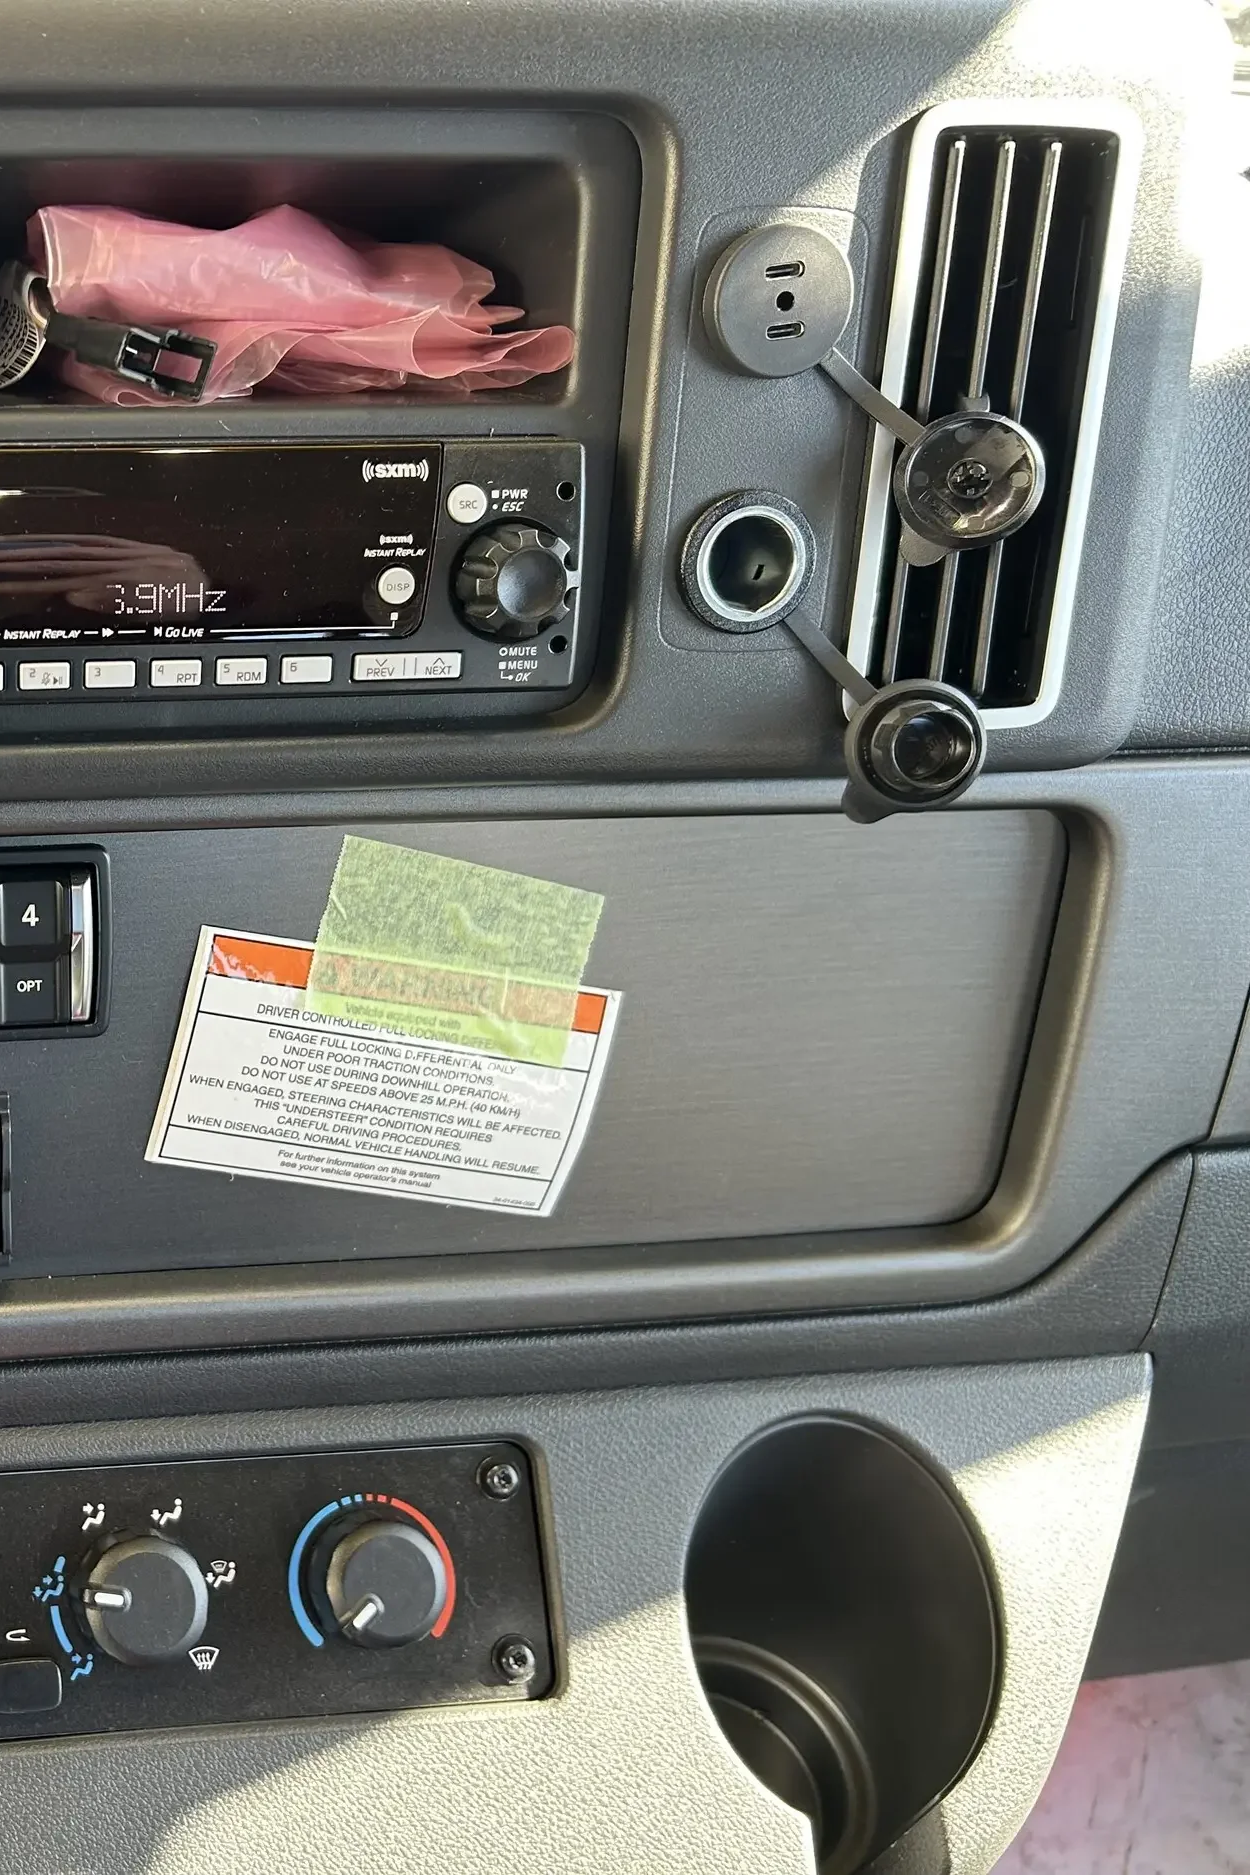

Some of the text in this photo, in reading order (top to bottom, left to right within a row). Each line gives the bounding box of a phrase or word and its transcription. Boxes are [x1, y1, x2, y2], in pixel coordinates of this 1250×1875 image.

[502, 489, 528, 499] PWR
[459, 500, 478, 510] SRC
[502, 502, 525, 512] ESC
[386, 582, 410, 592] DISP
[508, 647, 538, 656] MUTE
[224, 664, 230, 673] 5
[290, 662, 297, 672] 6
[508, 660, 538, 670] MENU
[29, 668, 36, 678] 2
[94, 668, 101, 677] 3
[157, 666, 164, 675] 4
[366, 667, 395, 677] PREV
[425, 666, 452, 676] NEXT
[176, 673, 198, 684] RPT
[515, 672, 532, 682] OK
[20, 904, 40, 928] 4
[16, 978, 44, 994] OPT
[256, 1004, 459, 1044] DRIVER CONTROLLED FULL LOCKING
[268, 1028, 317, 1045] ENGAGE
[320, 1037, 348, 1050] FULL
[350, 1041, 402, 1058] LOCKING
[487, 1062, 518, 1075] ONLY
[283, 1045, 495, 1087] UNDER POOR TRACTION CONDITIONS.
[260, 1056, 278, 1067] DO
[280, 1059, 306, 1071] NOT
[307, 1063, 332, 1075] USE
[333, 1066, 379, 1082] DURING
[381, 1073, 440, 1092] DOWNHILL
[241, 1066, 521, 1118] DO NOT USE AT SPEEDS ABOVE 25 M.P.H. (40 KM/H)
[189, 1074, 562, 1140] WHEN ENGAGED, STEERING CHARACTERISTICS WILL BE AFFECTED.
[254, 1098, 280, 1111] THIS
[369, 1116, 432, 1135] CONDITION
[434, 1127, 493, 1143] REQUIRES
[277, 1116, 462, 1152] CAREFUL DRIVING PROCEDURES.
[187, 1114, 540, 1175] WHEN DISENGAGED, NORMAL VEHICLE HANDLING WILL RESUME.
[278, 1149, 440, 1182] For further information on this system
[280, 1161, 432, 1188] see your vehicle operator's manual
